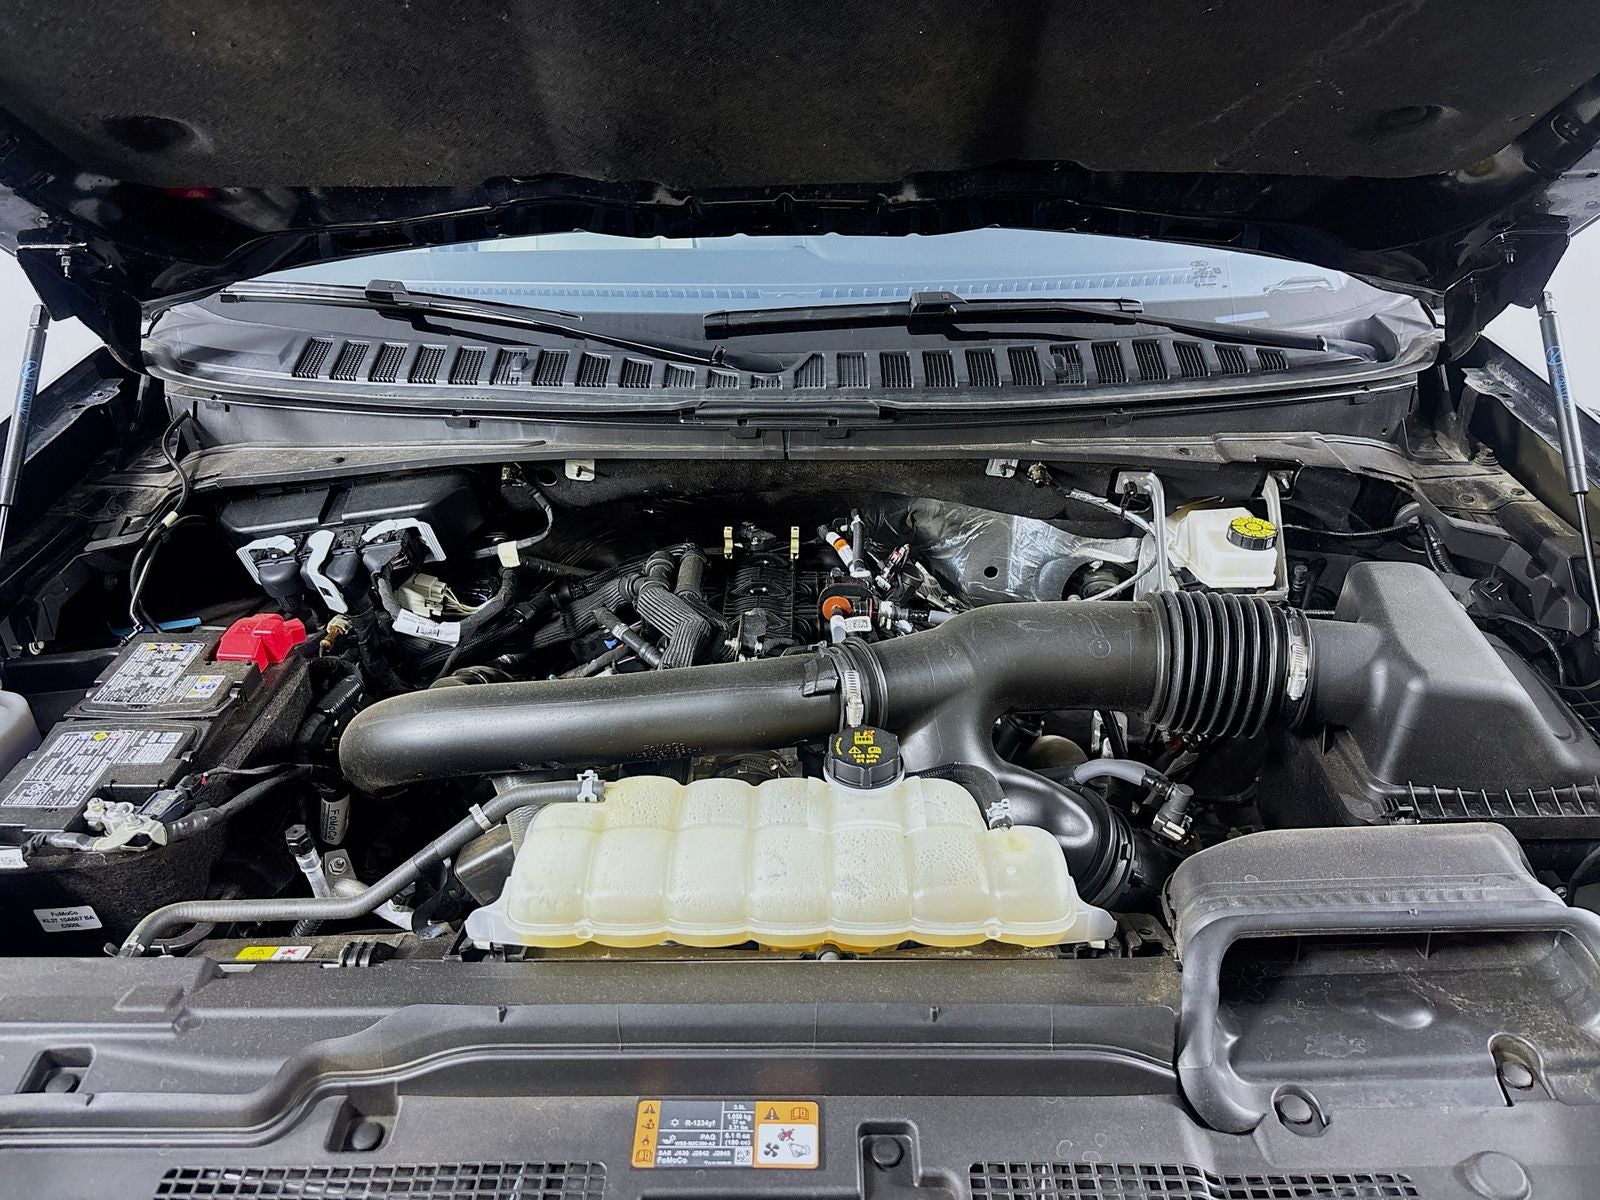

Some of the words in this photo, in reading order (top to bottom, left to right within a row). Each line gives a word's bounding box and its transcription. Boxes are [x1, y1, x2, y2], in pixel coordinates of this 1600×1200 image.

[328, 809, 339, 840] FoMoCo
[744, 1113, 752, 1122] kg
[685, 1119, 716, 1128] R-1234yf
[656, 1157, 688, 1165] FoMoCo
